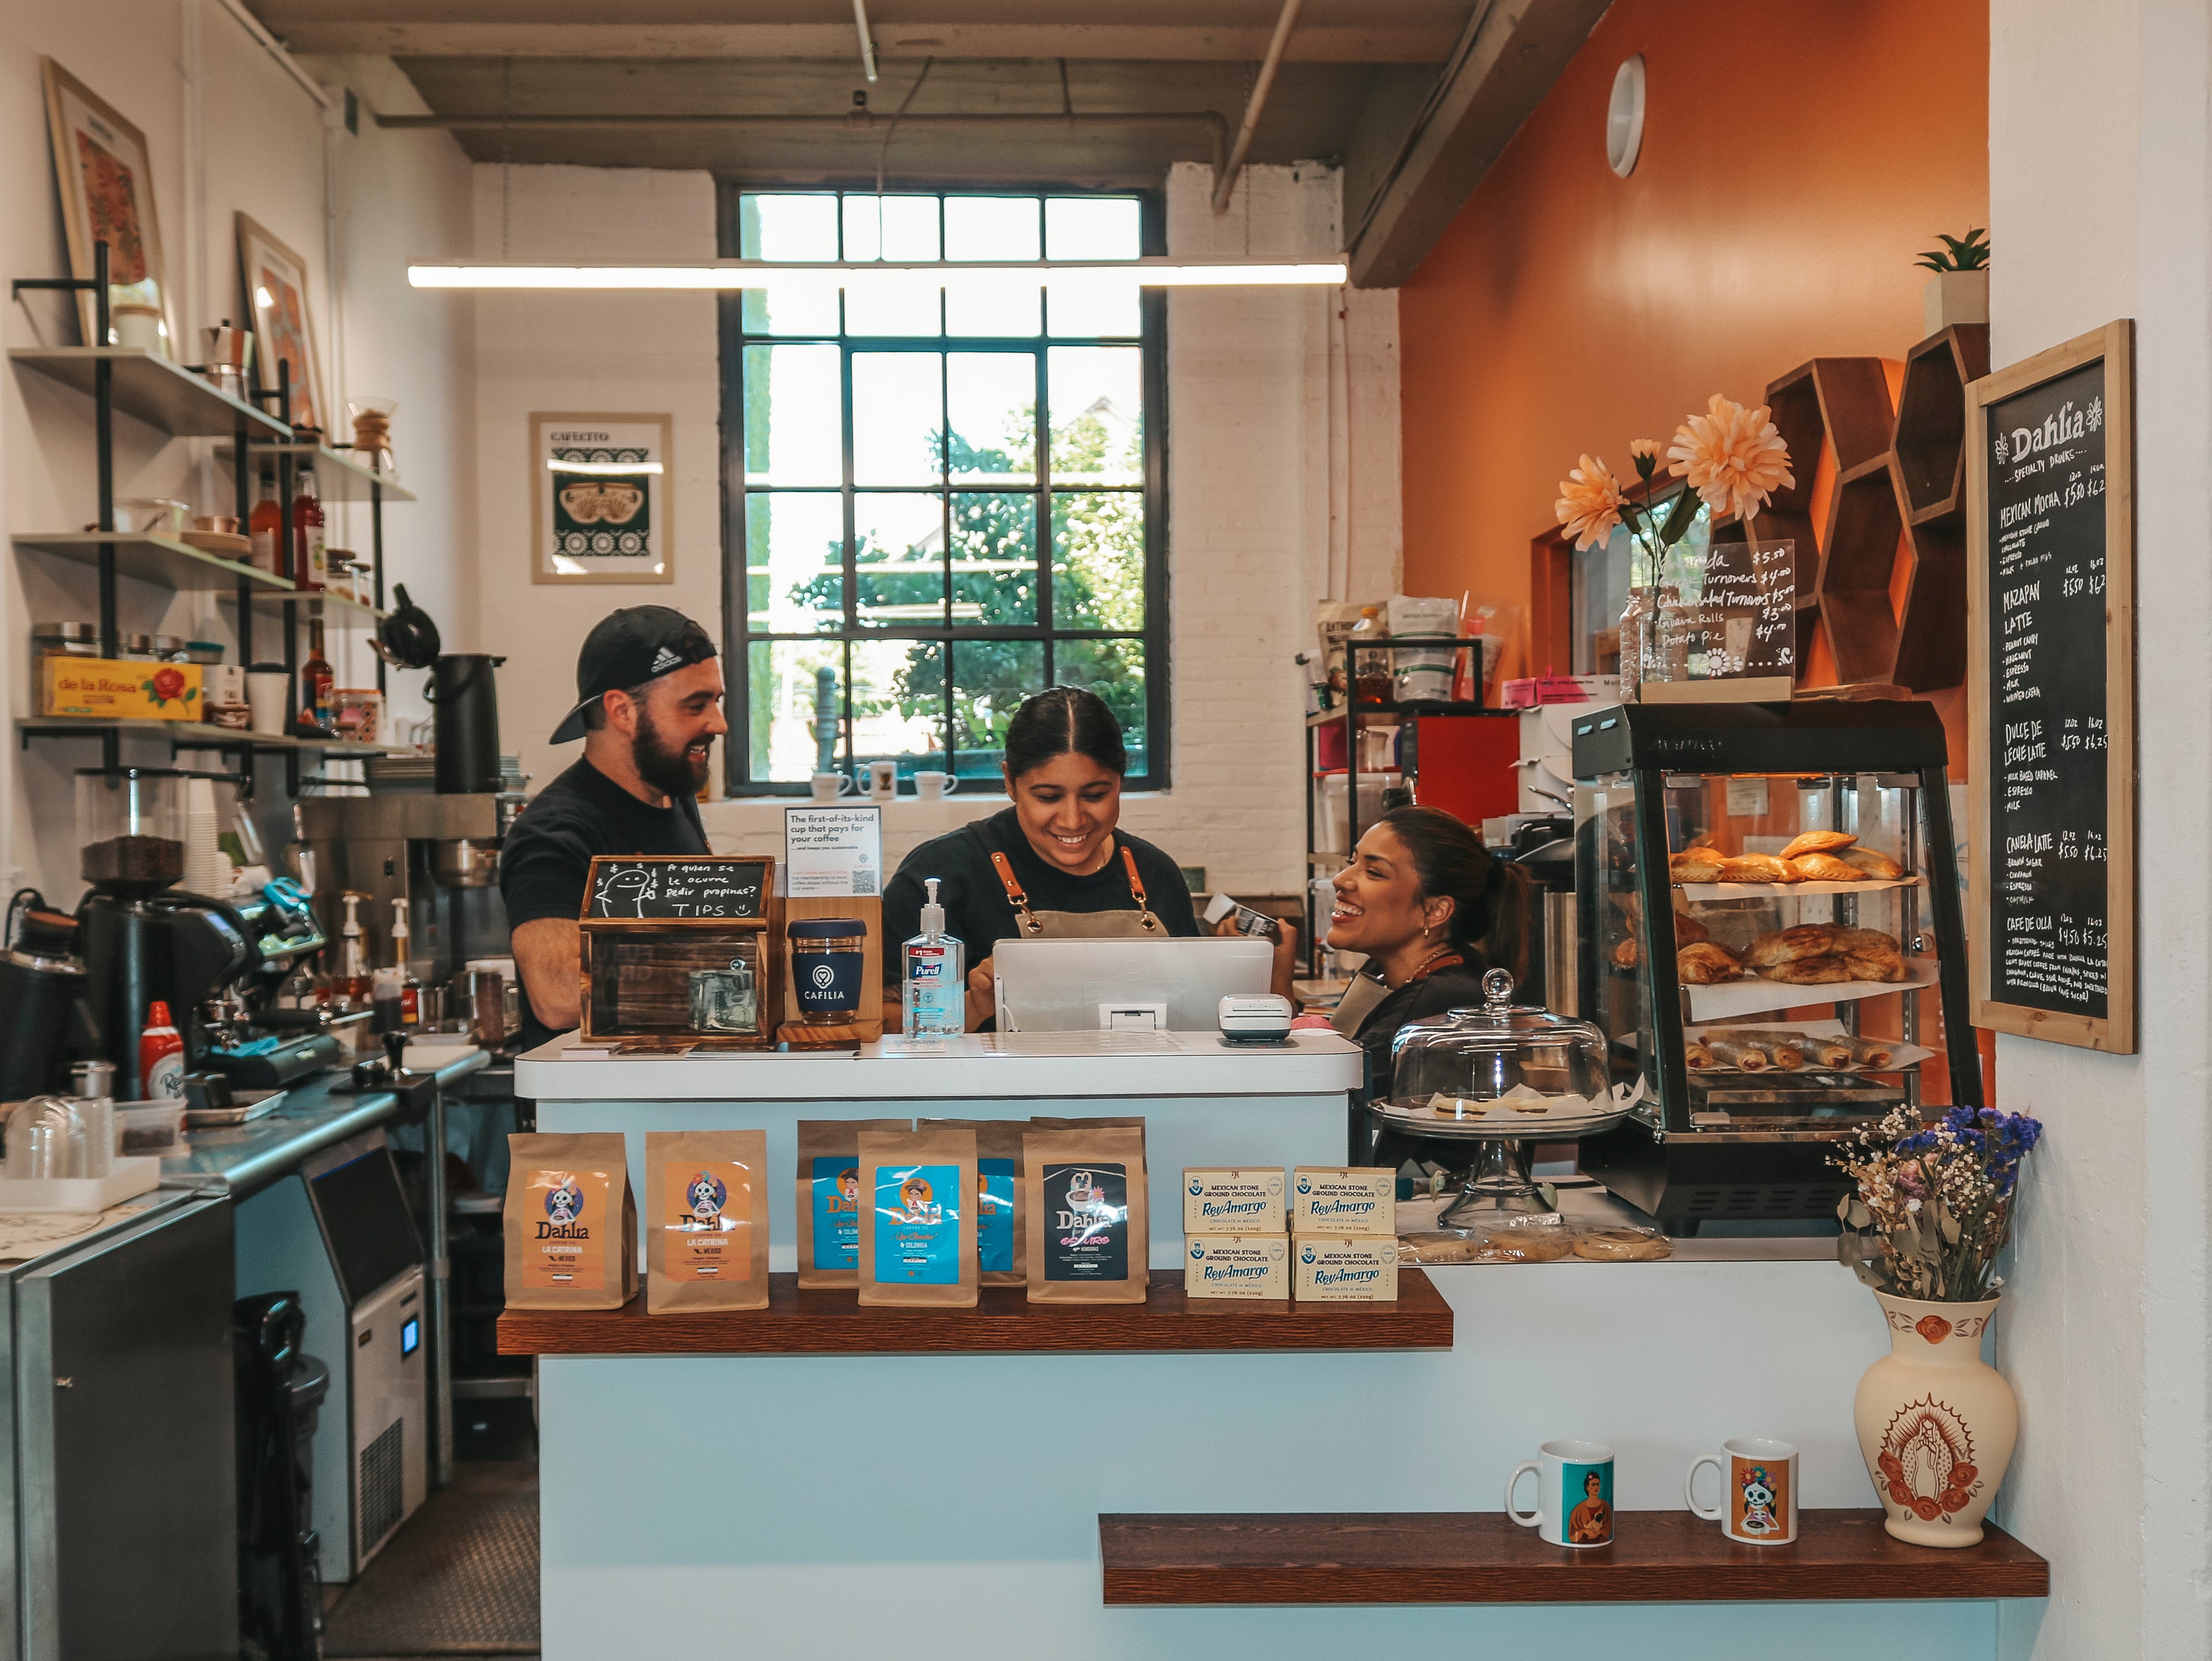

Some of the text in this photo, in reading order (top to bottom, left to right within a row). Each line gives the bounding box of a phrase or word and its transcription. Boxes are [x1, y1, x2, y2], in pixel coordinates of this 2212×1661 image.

[2012, 401, 2085, 462] Dahlia
[2001, 491, 2061, 529] MEXICAN MOCHA
[1753, 548, 1785, 565] $5.50
[1703, 573, 1757, 585] Turnovers
[2003, 580, 2040, 613] MAZAPAN
[1699, 612, 1724, 623] Rolls
[2005, 611, 2032, 634] LATTE
[2006, 720, 2043, 746] DULCE DE
[2005, 742, 2047, 768] LECHE LATTE
[2008, 786, 2033, 797] ESPRESSO
[2007, 800, 2021, 812] MILK
[808, 814, 874, 822] first-of-its-kind
[828, 826, 849, 834] pays
[2006, 833, 2053, 854] CANELA LATTE
[681, 865, 711, 873] quien
[2025, 858, 2043, 867] SUGAR
[703, 886, 756, 898] propinas?
[2009, 882, 2032, 892] ESPRESSO
[672, 904, 725, 916] TIPS
[2007, 916, 2052, 932] CAFE DE OLLA
[915, 966, 940, 974] Purell
[804, 991, 845, 1000] CAFILIA
[1203, 1200, 1267, 1217] ReyAmargo
[1310, 1200, 1376, 1216] ReyAmargo
[535, 1220, 589, 1239] Dahlia
[1205, 1265, 1268, 1280] ReyAmargo
[1315, 1268, 1380, 1285] ReyAmargo
